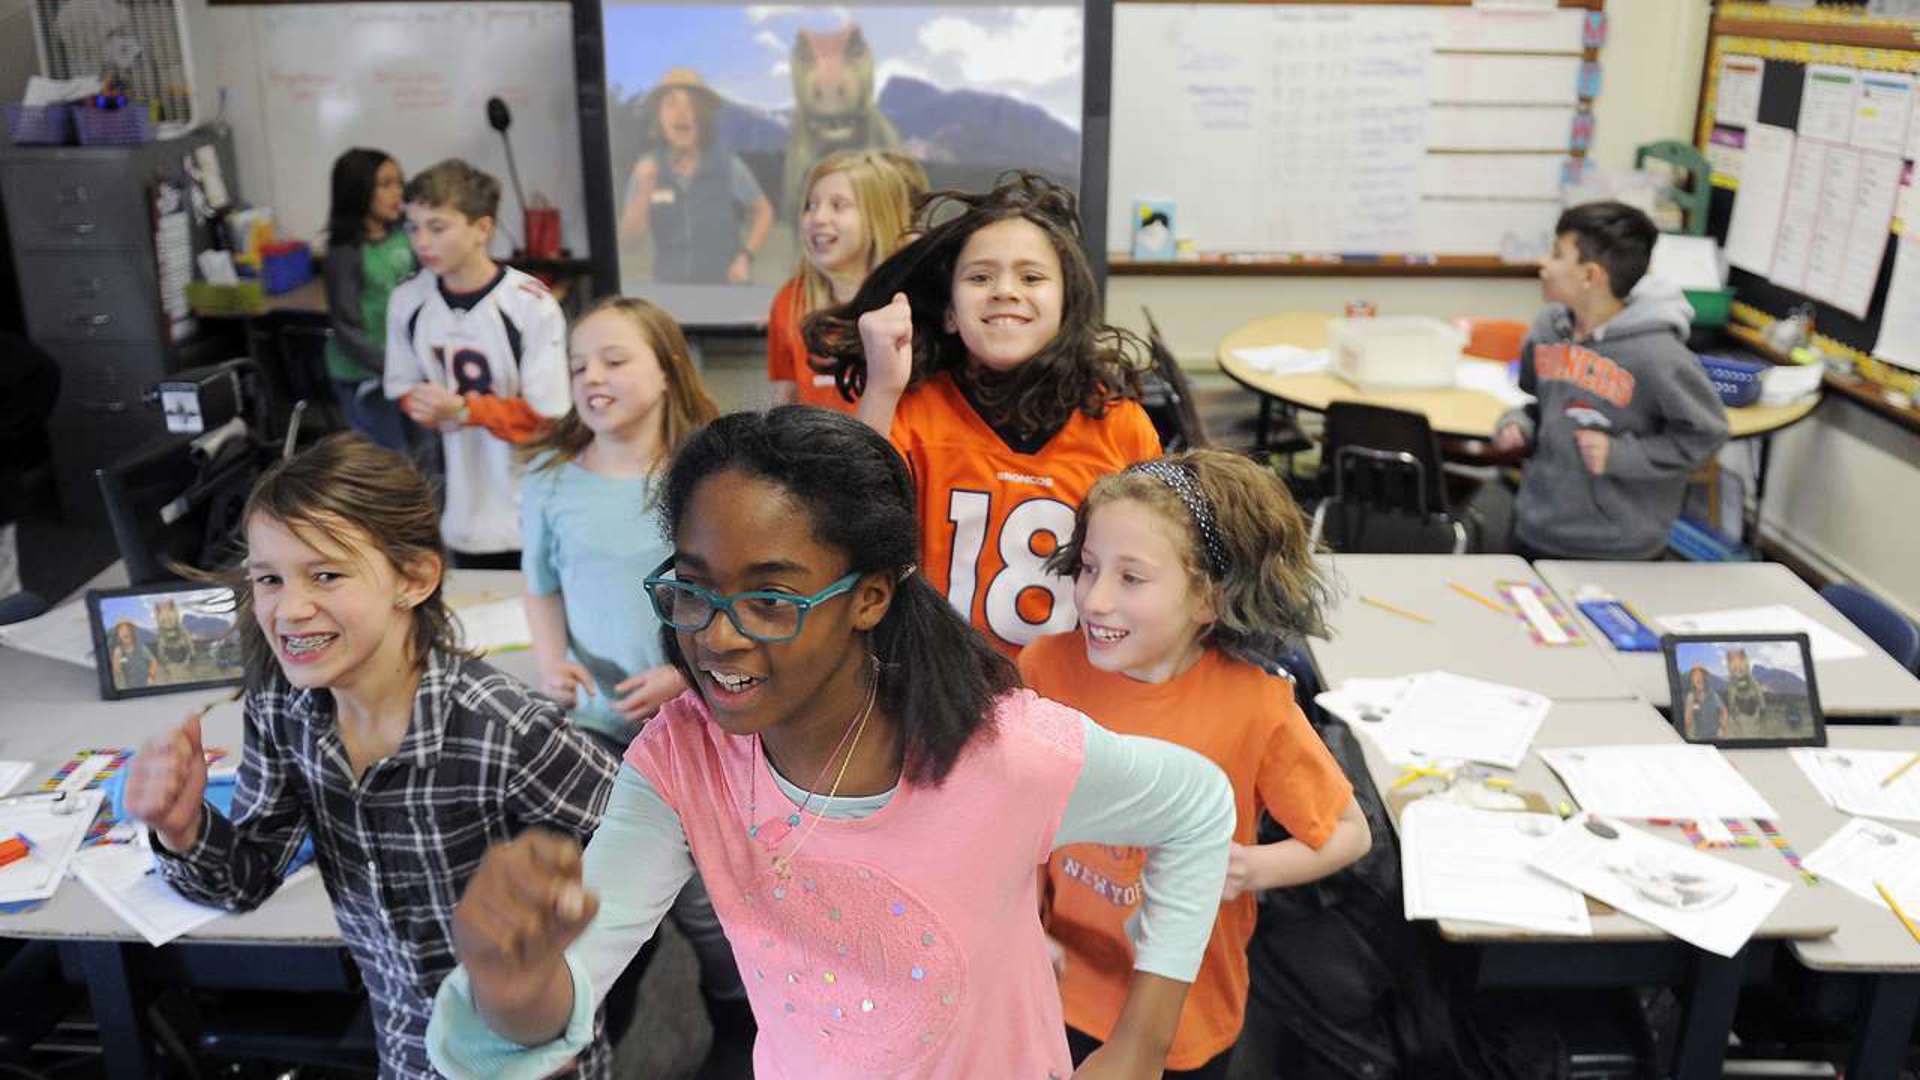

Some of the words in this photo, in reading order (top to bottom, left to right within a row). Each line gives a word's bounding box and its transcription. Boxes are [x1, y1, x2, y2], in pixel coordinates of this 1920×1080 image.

[996, 471, 1054, 488] BRONCOS
[948, 489, 1080, 647] 18
[1063, 856, 1108, 897] NEW
